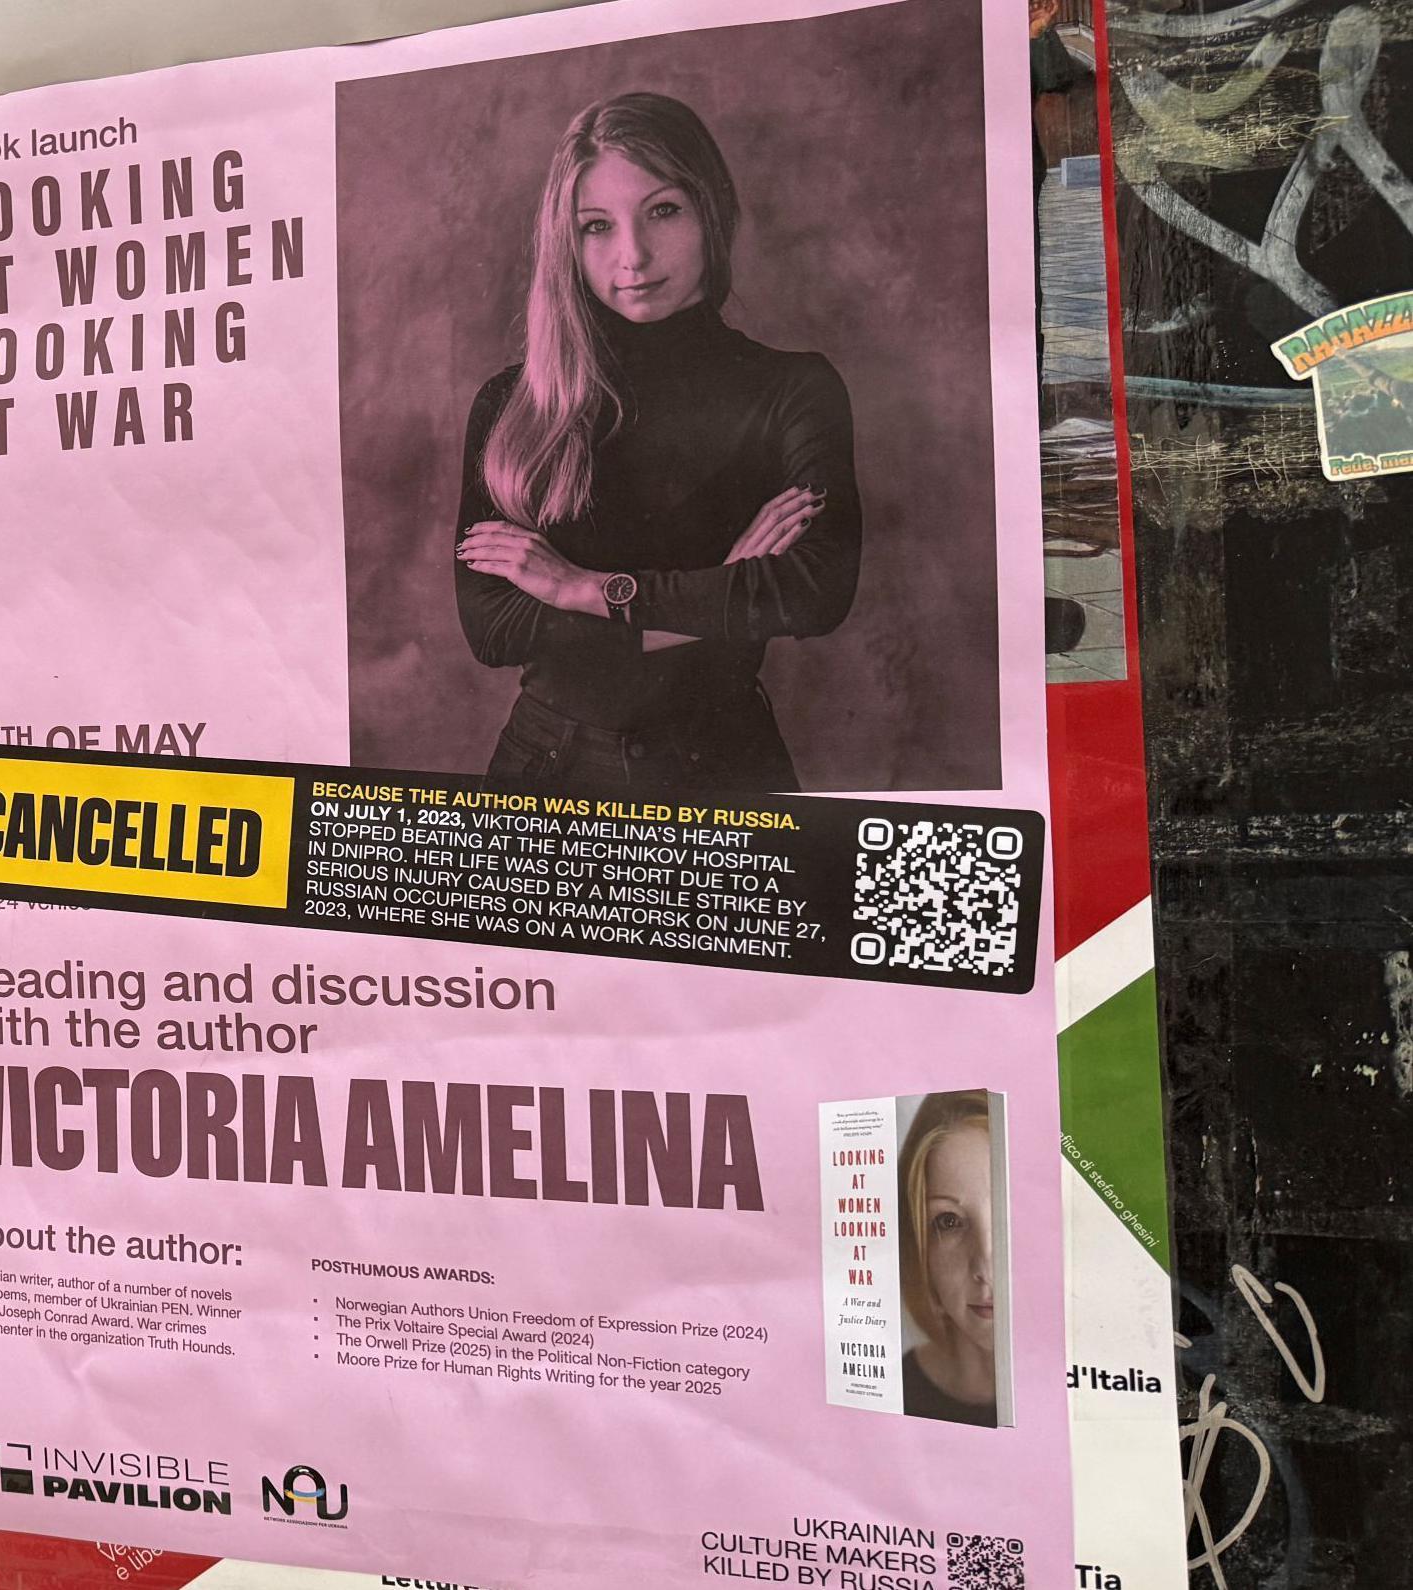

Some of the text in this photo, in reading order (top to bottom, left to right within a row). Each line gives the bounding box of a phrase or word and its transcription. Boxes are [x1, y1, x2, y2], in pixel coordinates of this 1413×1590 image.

[31, 116, 136, 156] launch
[54, 216, 303, 306] WOMEN
[1278, 294, 1413, 376] RAGAZZ
[55, 382, 193, 450] WAR
[46, 725, 101, 750] OF
[115, 722, 207, 757] MAY
[310, 801, 338, 817] ON
[344, 803, 391, 821] JULY
[397, 807, 411, 825] 1,
[417, 809, 465, 829] 2023,
[472, 812, 561, 834] VIKTORIA
[682, 828, 753, 847] HEART
[312, 781, 799, 829] BECAUSE THE AUTHOR WAS KILLED BY RUSSIA.
[308, 840, 778, 893] IN DNIPRO. HER LIFE WAS CUT SHORT DUE TO A
[309, 820, 795, 873] STOPPED BEATING AT THE MECHNIKOV HOSPITAL
[306, 860, 806, 916] SERIOUS INJURY CAUSED BY A MISSILE STRIKE BY
[304, 899, 791, 958] 2023, WHERE SHE WAS ON A WORK ASSIGNMENT.
[306, 879, 825, 942] RUSSIAN OCCUPIERS ON KRAMATORSK ON JUNE 27,
[163, 963, 252, 1003] and
[272, 963, 554, 1010] discussion
[64, 1008, 139, 1048] the
[157, 1012, 317, 1053] author
[341, 1079, 764, 1211] AMELINA
[833, 1148, 884, 1166] LOOKING
[852, 1173, 864, 1189] AT
[838, 1197, 880, 1212] WOMEN
[1080, 1160, 1094, 1172] di
[1089, 1170, 1124, 1209] stefano
[1119, 1210, 1160, 1247] ghesini
[65, 1225, 115, 1256] the
[126, 1233, 241, 1265] author:
[834, 1221, 885, 1237] LOOKING
[311, 1258, 494, 1284] POSTHUMOUS AWARDS:
[853, 1245, 866, 1260] AT
[19, 1273, 53, 1288] writer,
[57, 1276, 95, 1290] author
[97, 1279, 110, 1291] of
[113, 1283, 121, 1292] a
[124, 1283, 171, 1296] number
[174, 1285, 187, 1298] of
[190, 1288, 232, 1300] novels
[848, 1269, 872, 1285] WAR
[34, 1293, 82, 1306] member
[85, 1296, 97, 1307] of
[100, 1296, 157, 1313] Ukrainian
[161, 1301, 192, 1316] PEN.
[196, 1304, 241, 1318] Winner
[335, 1296, 767, 1343] Norwegian Authors Union Freedom of Expression Prize (2024)
[335, 1314, 593, 1349] The Prix Voltaire Special Award (2024)
[840, 1341, 885, 1358] VICTORIA
[842, 1362, 884, 1378] AMELINA
[1066, 1364, 1162, 1394] d'Italia
[44, 1447, 229, 1485] INVISIBLE
[43, 1475, 232, 1515] PAVILION
[261, 1465, 348, 1520] NAU
[701, 1531, 936, 1574] CULTURE MAKERS
[793, 1517, 934, 1549] UKRAINIAN
[703, 1555, 789, 1583] KILLED
[798, 1565, 832, 1587] BY
